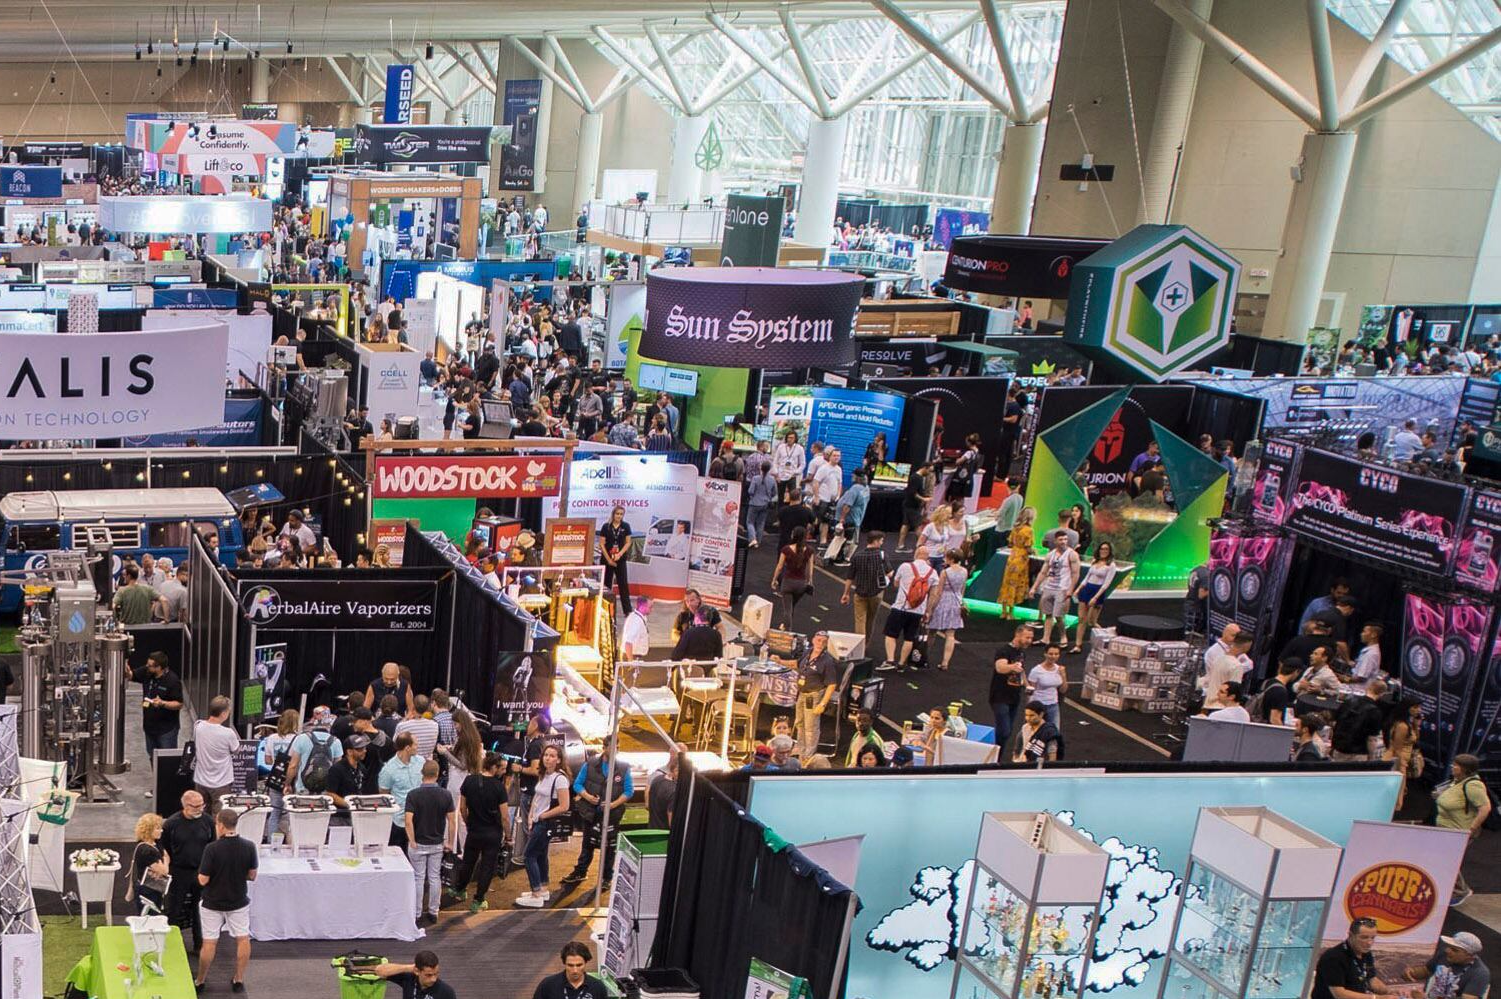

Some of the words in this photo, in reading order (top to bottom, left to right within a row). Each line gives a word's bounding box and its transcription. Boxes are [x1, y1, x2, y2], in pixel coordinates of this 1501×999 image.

[206, 128, 244, 140] Csume
[199, 140, 250, 149] Confidently.
[665, 303, 721, 341] Sun
[726, 309, 834, 350] System
[861, 350, 912, 360] RESOLVE
[25, 408, 150, 427] TECHNOLOGY
[774, 401, 809, 417] Ziel
[1267, 442, 1293, 459] CYCO
[379, 465, 518, 493] WOODSTOCK
[1359, 468, 1399, 493] CYCO
[572, 498, 609, 509] CONTROL
[611, 498, 650, 509] SERVICES
[1337, 506, 1374, 526] Platinum
[1374, 516, 1407, 534] Series
[347, 601, 432, 619] Vaporizers
[390, 620, 405, 629] Est.
[407, 620, 427, 629] 2004
[502, 700, 526, 709] want
[526, 702, 544, 711] you
[1361, 862, 1423, 903] PUFF
